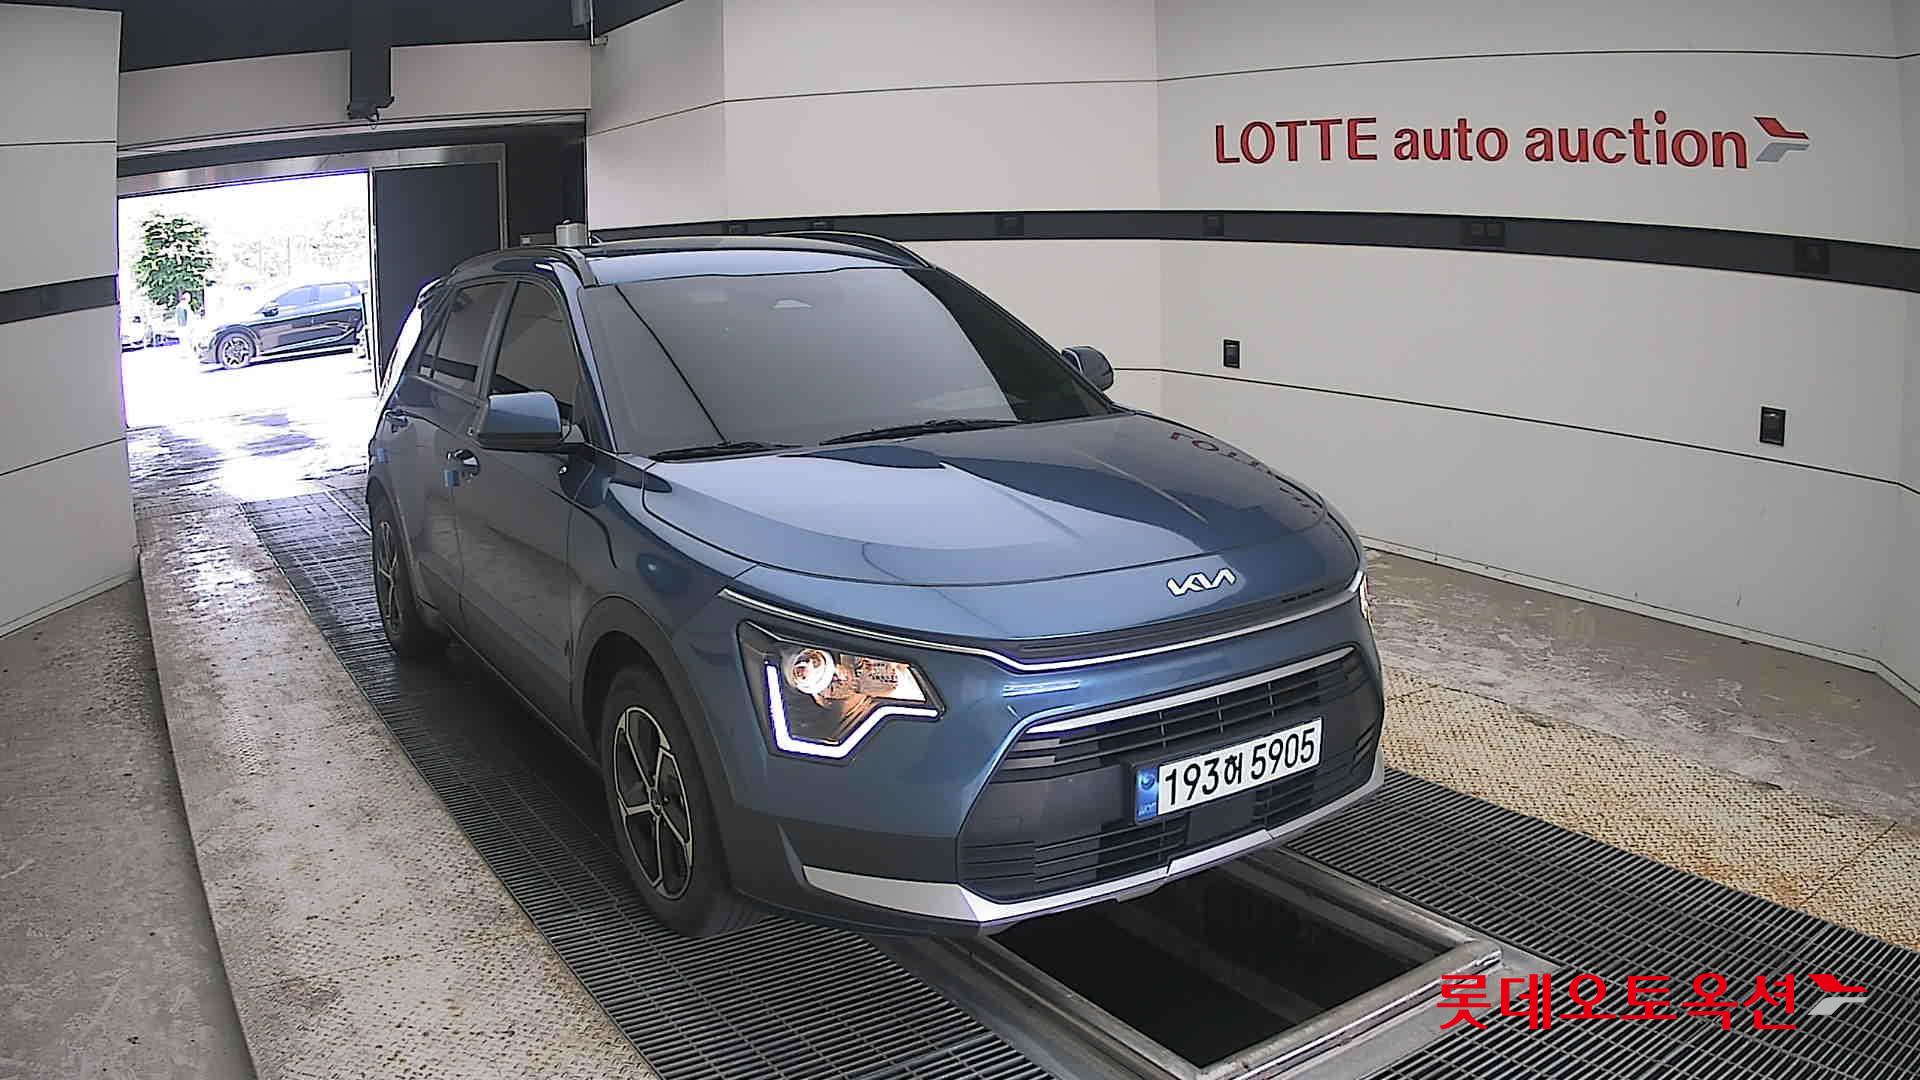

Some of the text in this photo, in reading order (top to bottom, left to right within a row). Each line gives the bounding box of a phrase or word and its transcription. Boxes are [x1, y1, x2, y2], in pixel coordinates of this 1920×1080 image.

[1215, 110, 1749, 169] LOTTE auto auction
[1250, 727, 1315, 780] 5905
